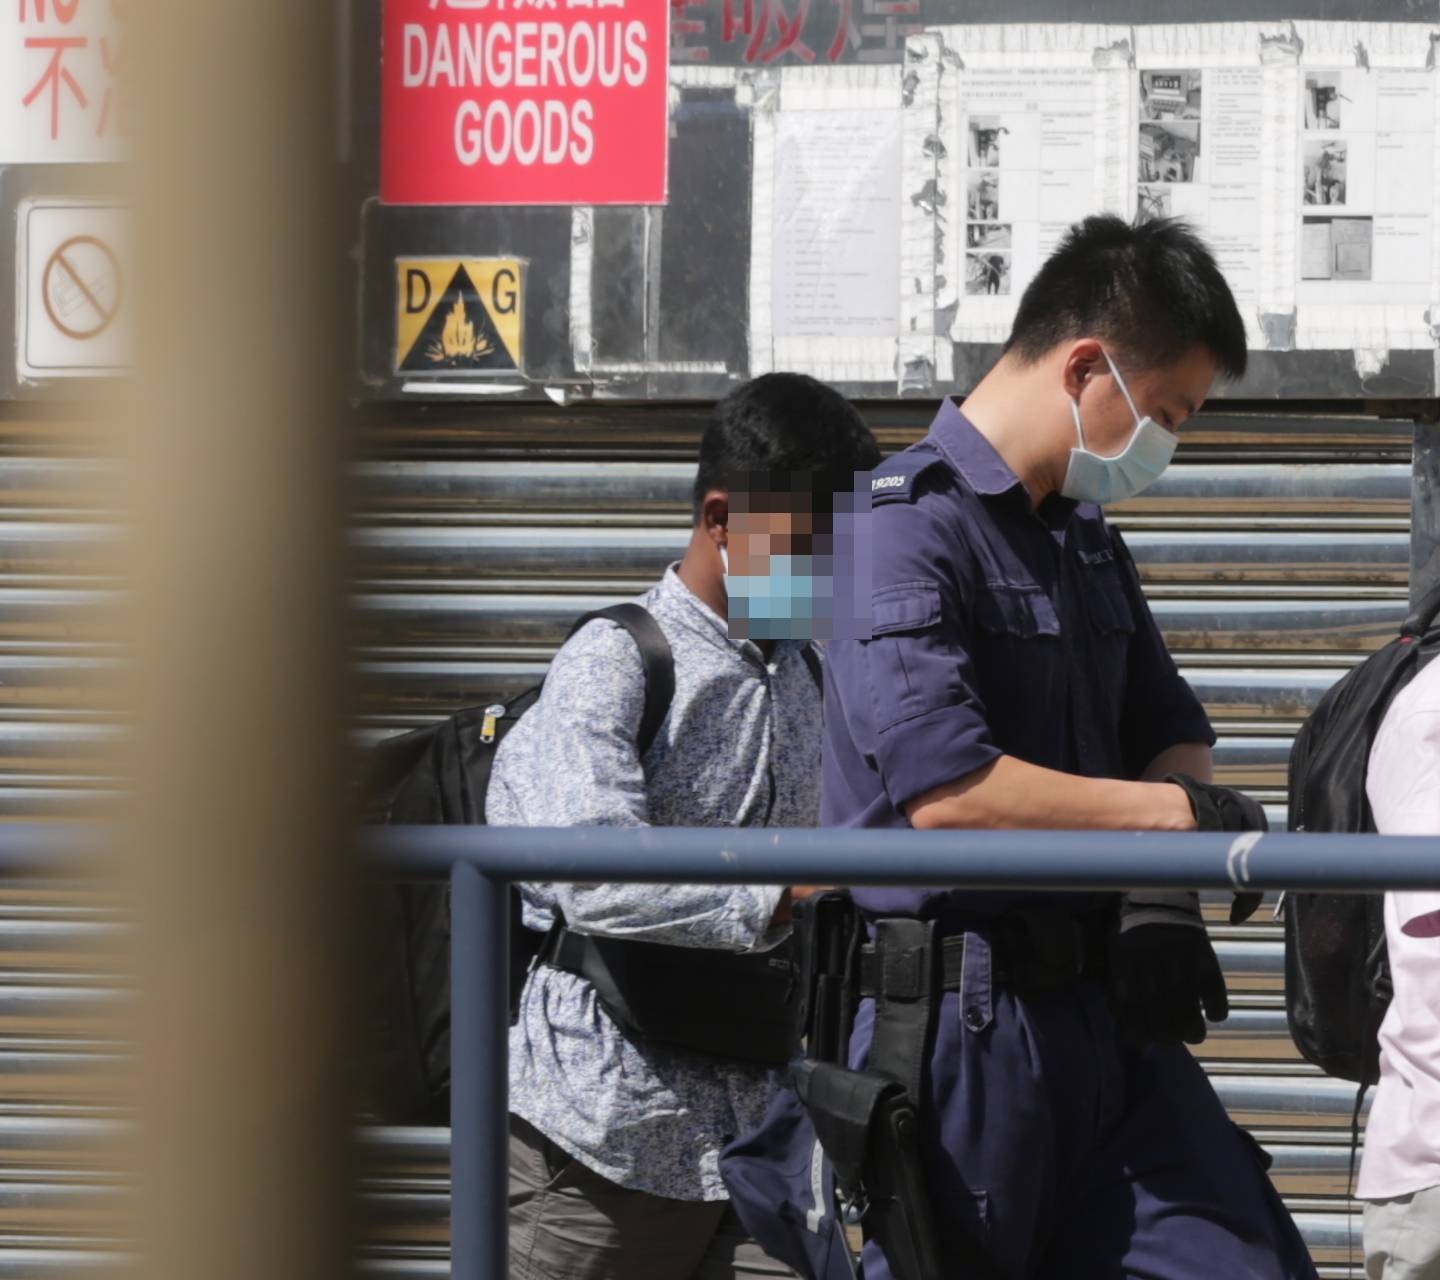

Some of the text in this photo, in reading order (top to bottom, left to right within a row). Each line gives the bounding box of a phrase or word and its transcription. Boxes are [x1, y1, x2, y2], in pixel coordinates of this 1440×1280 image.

[402, 20, 648, 88] DANGEROUS
[454, 98, 595, 166] GOODS
[405, 269, 431, 314] D
[492, 268, 517, 315] G
